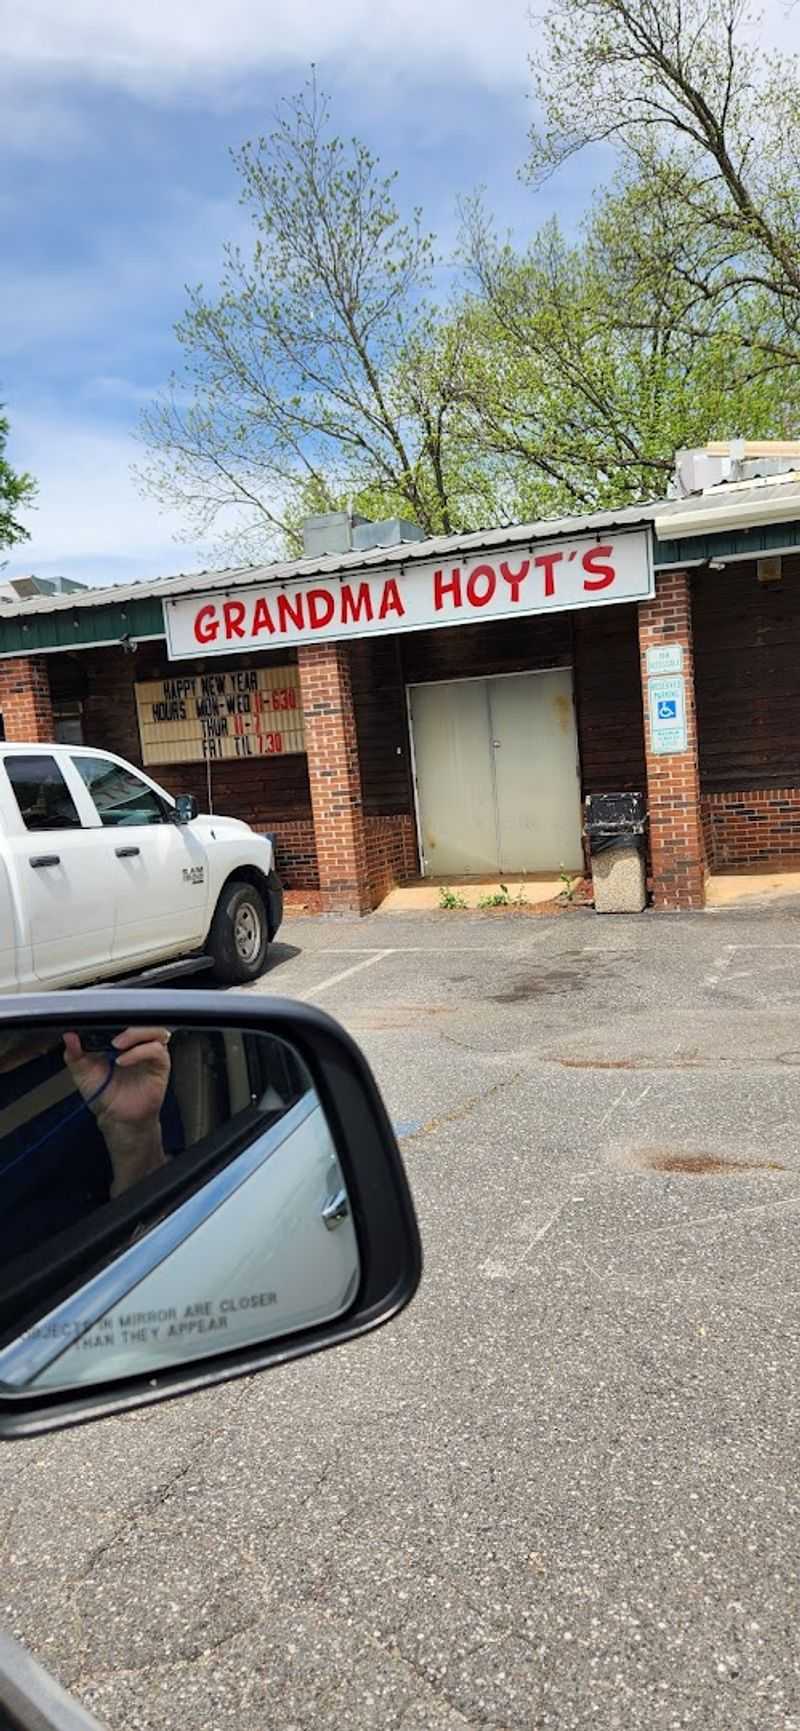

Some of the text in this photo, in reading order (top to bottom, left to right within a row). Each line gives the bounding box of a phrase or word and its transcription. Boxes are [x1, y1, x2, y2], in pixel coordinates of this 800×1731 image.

[193, 544, 616, 645] GRANDMA HOYT'S
[163, 671, 258, 700] HAPPY NEW YEAR
[152, 701, 187, 722] HOURS
[201, 713, 262, 738] THUR 11-7
[202, 738, 223, 758] FRI
[234, 736, 253, 756] TIL
[119, 1308, 177, 1328] MIRROR
[184, 1302, 213, 1319] ARE
[219, 1291, 279, 1311] CLOSER
[122, 1326, 160, 1345] THEY
[167, 1315, 229, 1339] APPEAR
